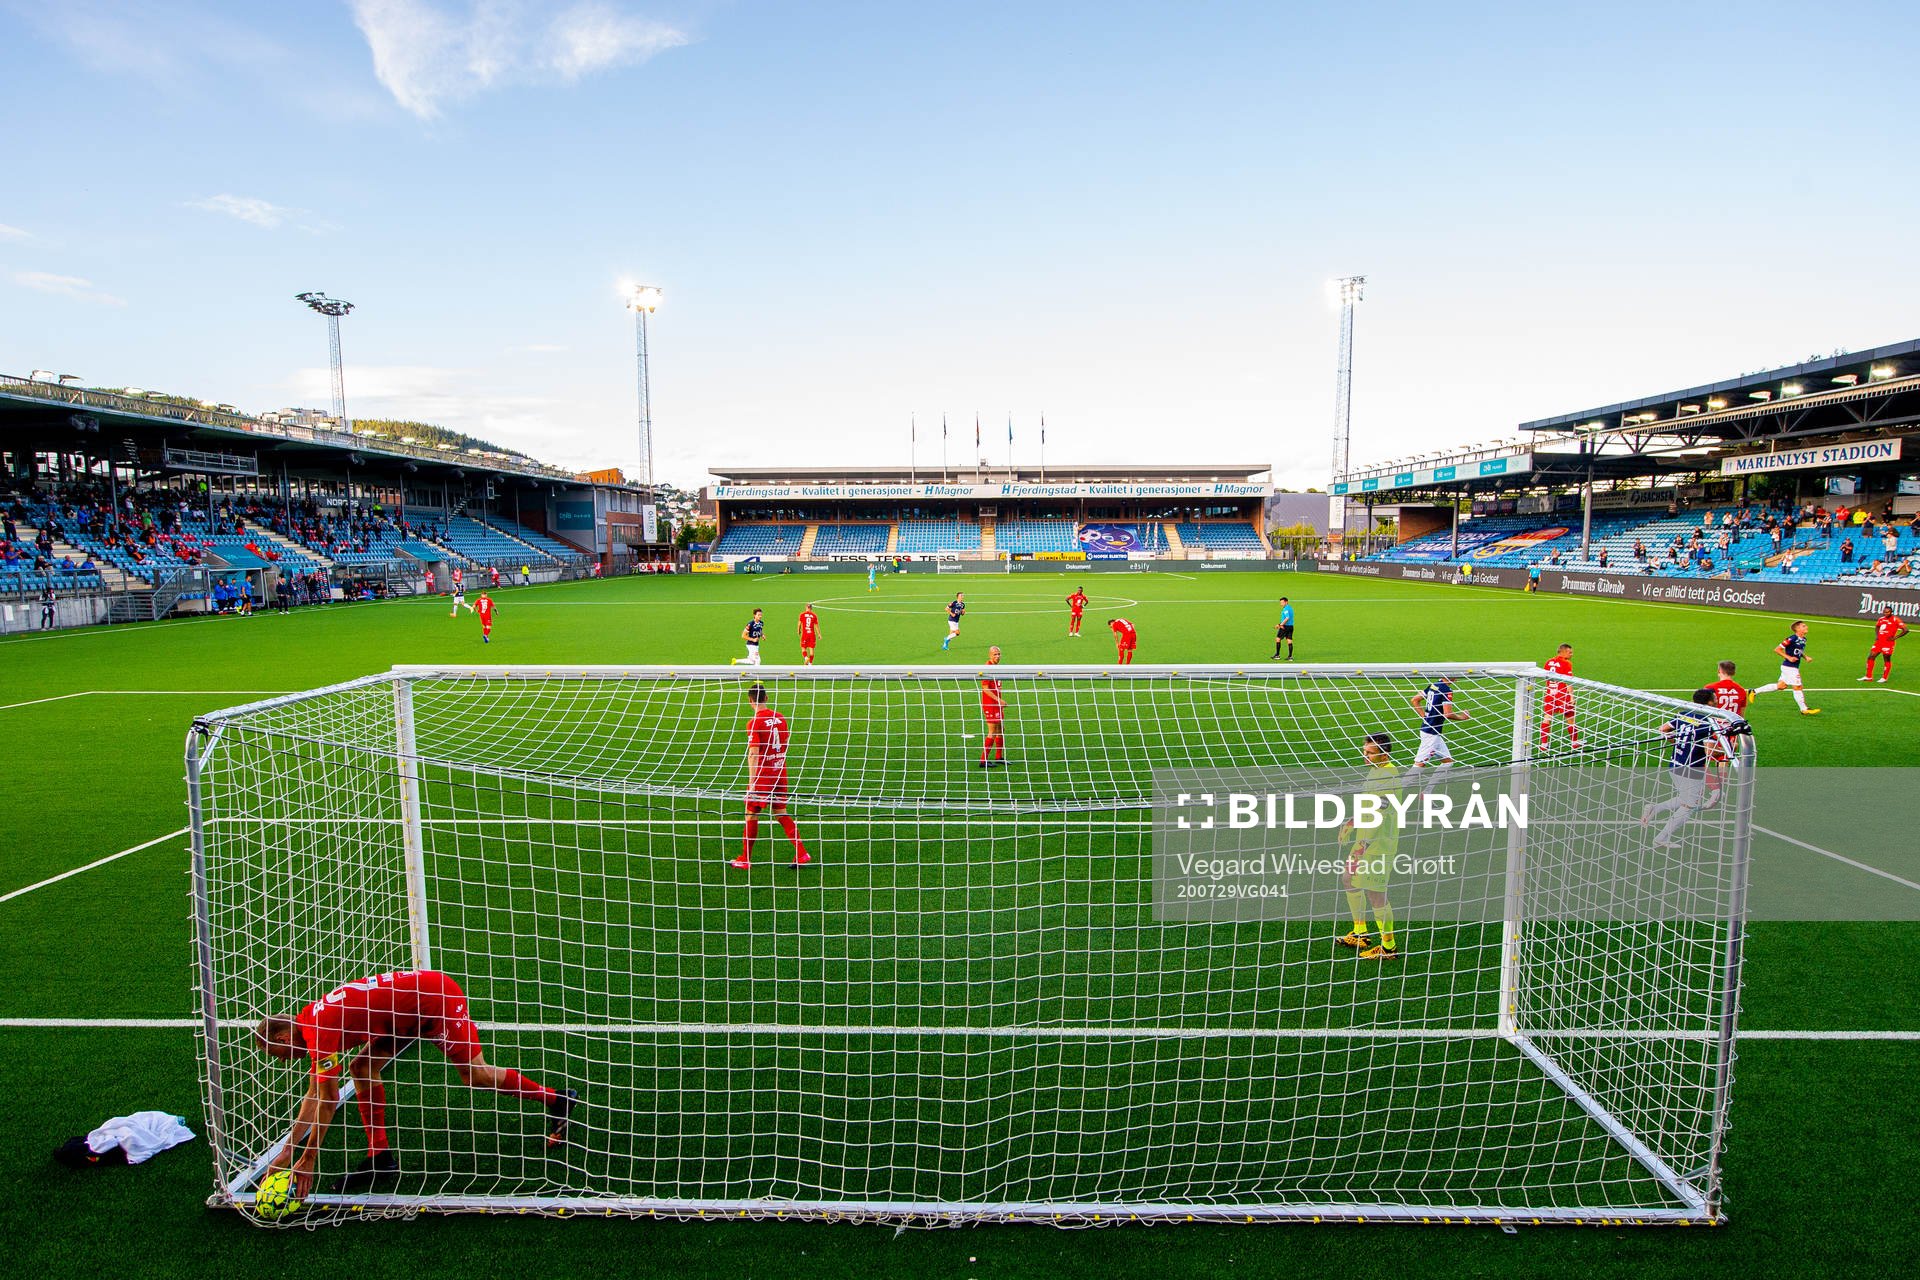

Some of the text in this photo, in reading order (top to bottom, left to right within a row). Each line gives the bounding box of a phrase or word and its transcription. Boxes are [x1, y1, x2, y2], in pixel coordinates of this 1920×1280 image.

[1736, 443, 1893, 471] MARIENLYST STADION
[726, 487, 790, 498] Fjerdingstad
[802, 487, 839, 496] Kvalitet
[848, 487, 912, 497] generasjoner
[935, 486, 973, 496] Magnor
[1012, 485, 1077, 496] Fjerdingstad
[1089, 485, 1127, 494] Kvalitet
[1136, 485, 1201, 496] generasjoner
[1224, 484, 1264, 495] Magnor
[1481, 573, 1499, 584] Godset
[1561, 575, 1625, 594] Drammens Tidende
[1642, 583, 1651, 596] Vi
[1652, 586, 1664, 597] er
[1665, 585, 1686, 599] alltid
[1688, 587, 1705, 601] tett
[1705, 586, 1720, 604] på
[1723, 588, 1766, 606] Godset
[1857, 592, 1920, 617] Dramme
[1718, 695, 1739, 713] 25
[764, 718, 782, 726] BA
[771, 727, 782, 752] 4
